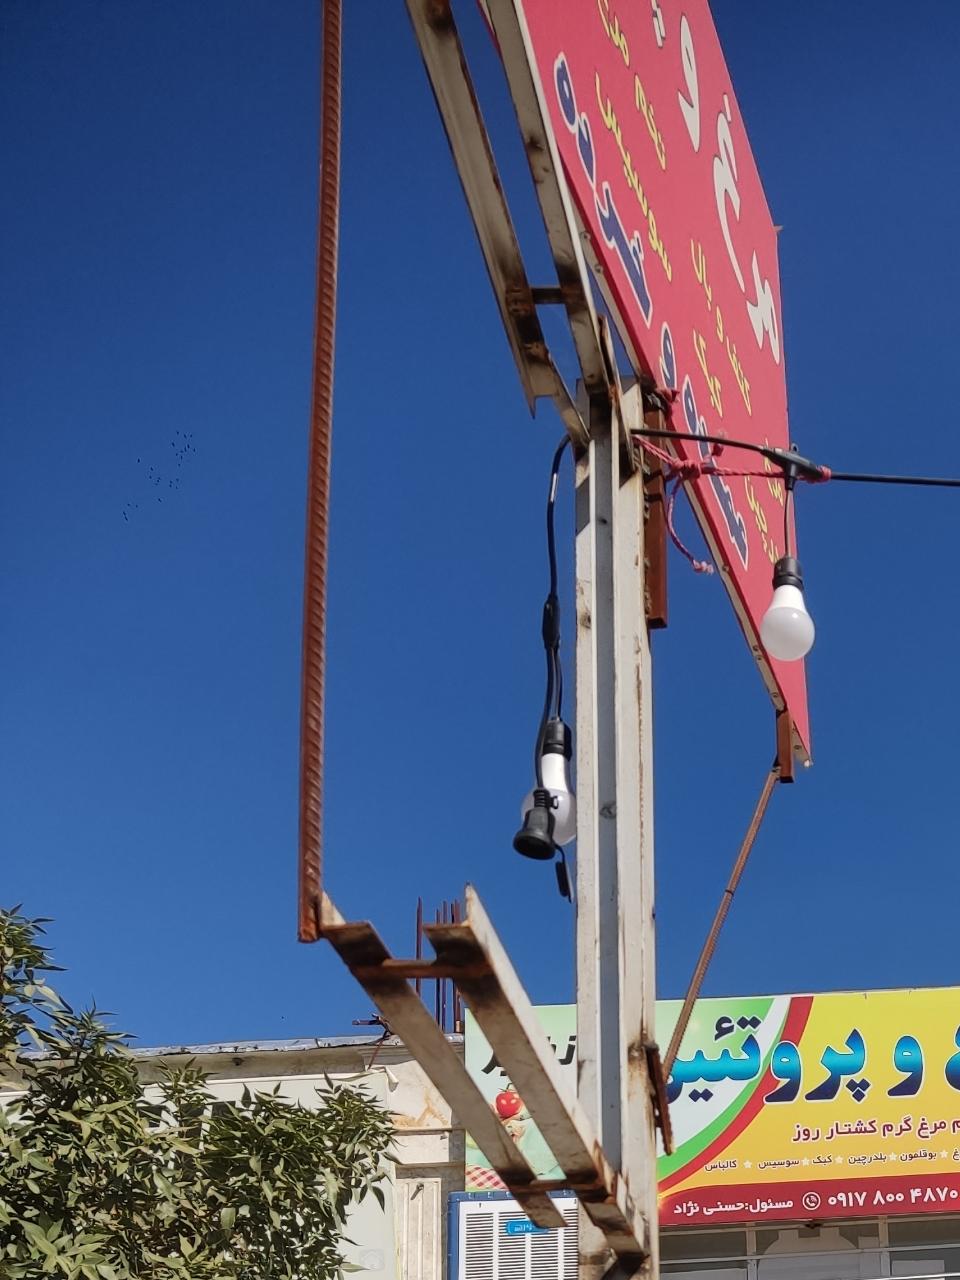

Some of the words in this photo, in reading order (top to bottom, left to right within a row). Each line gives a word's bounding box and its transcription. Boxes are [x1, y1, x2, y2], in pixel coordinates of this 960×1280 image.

[679, 13, 701, 152] و
[634, 73, 666, 171] تخم
[594, 70, 672, 283] سوسیس
[554, 51, 654, 329] خرده
[713, 95, 780, 364] مرغ
[691, 239, 711, 311] بال
[693, 329, 722, 418] کبک
[727, 336, 751, 416] کتف
[682, 374, 748, 572] عمده
[888, 1035, 925, 1097] و
[792, 1124, 820, 1142] روز
[826, 1119, 877, 1140] کشتار
[882, 1116, 912, 1136] گرم
[917, 1117, 947, 1138] مرغ
[704, 1160, 737, 1171] کالباس
[758, 1158, 800, 1169] سوسیس
[812, 1155, 833, 1164] کبک
[848, 1153, 887, 1165] بلدرچین
[900, 1149, 937, 1161] بوقلمون
[828, 1191, 867, 1207] ۰۹۱۷
[910, 1187, 959, 1204] ۴۸۷۰
[673, 1201, 700, 1217] نژاد
